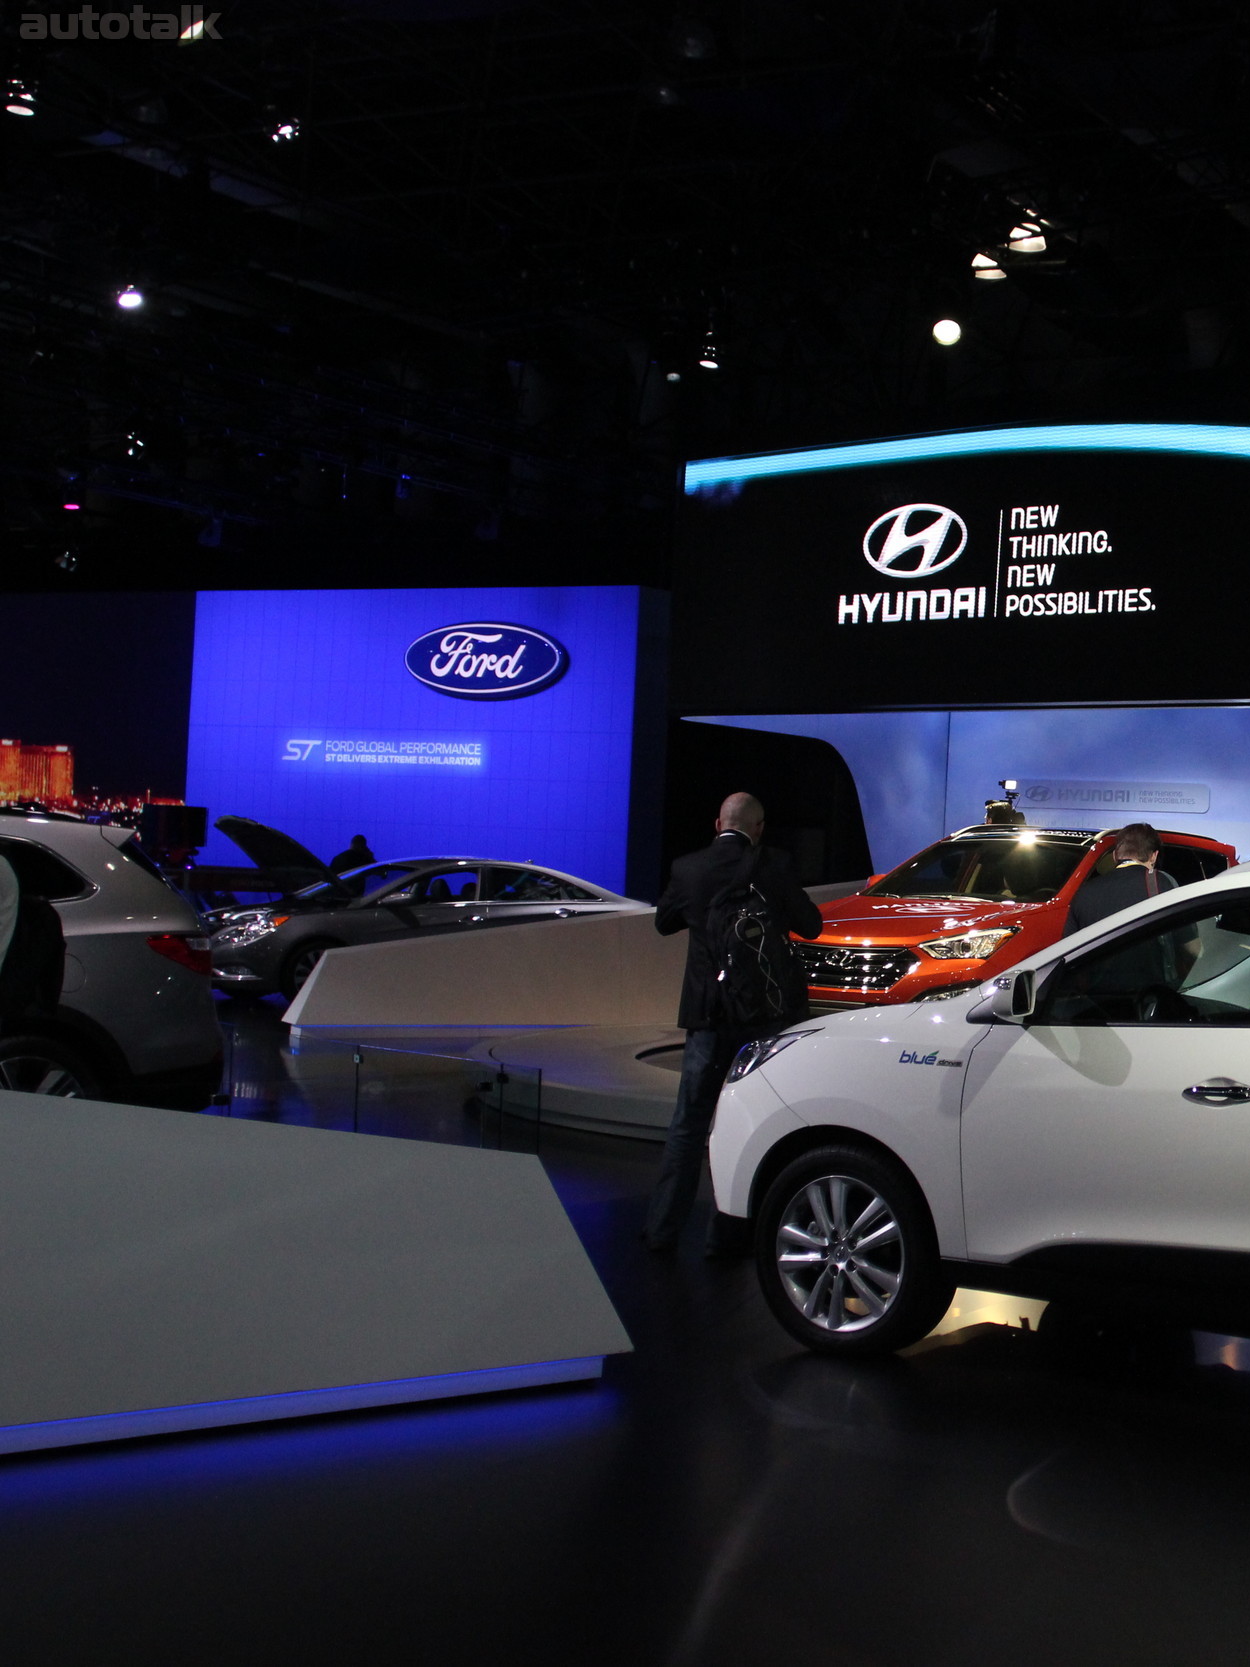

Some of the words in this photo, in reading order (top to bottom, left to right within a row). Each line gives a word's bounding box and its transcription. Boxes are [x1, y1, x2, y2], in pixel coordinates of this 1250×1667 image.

[1010, 504, 1060, 530] NEW
[1009, 530, 1112, 558] THINKING.
[1006, 563, 1056, 588] NEW
[838, 586, 986, 624] HYUNDAI
[1005, 587, 1156, 617] POSSIBILITIES.
[430, 631, 526, 679] Ford
[282, 739, 322, 761] ST
[325, 740, 354, 752] FORD
[355, 741, 397, 754] GLOBAL
[400, 742, 482, 756] PERFORMANCE
[325, 754, 336, 762] ST
[337, 754, 377, 763] DELIVERS
[378, 755, 417, 765] EXTREME
[418, 756, 481, 766] EXHILARATION
[1057, 788, 1130, 803] HYUNDAI
[899, 1050, 937, 1065] blue
